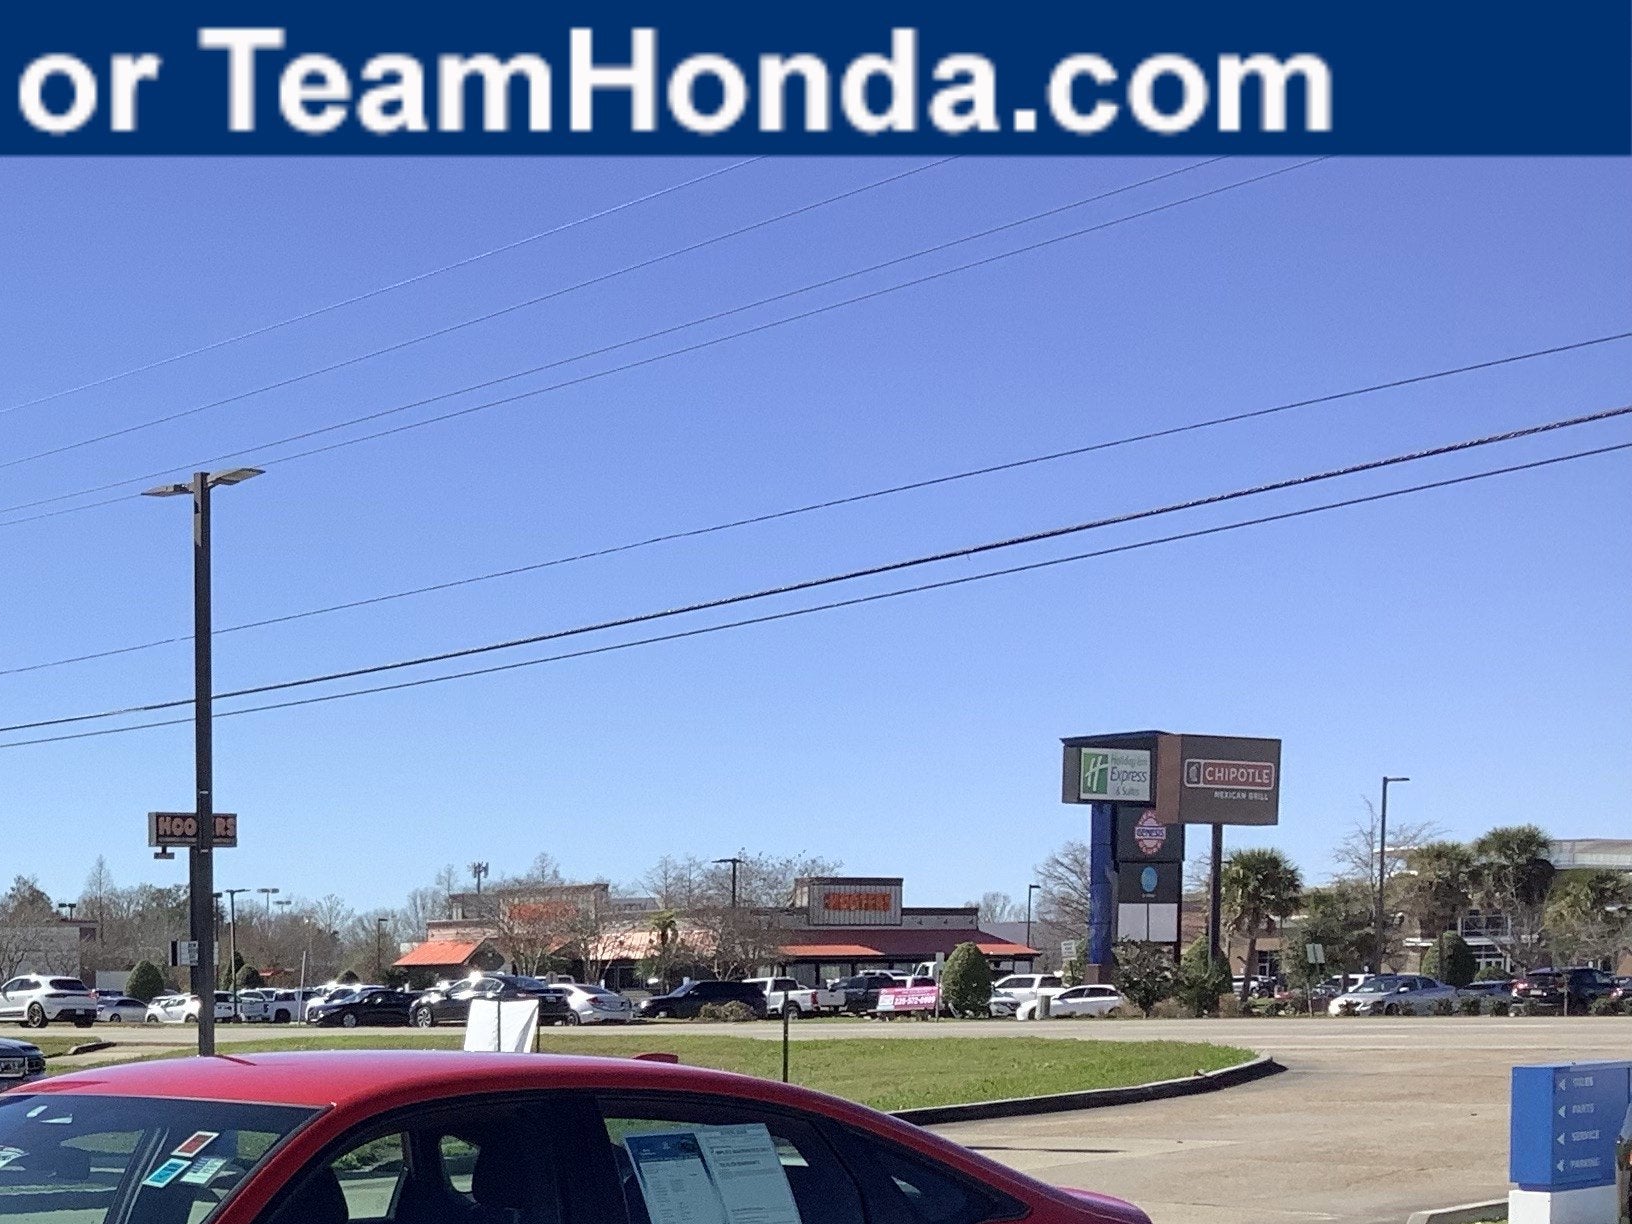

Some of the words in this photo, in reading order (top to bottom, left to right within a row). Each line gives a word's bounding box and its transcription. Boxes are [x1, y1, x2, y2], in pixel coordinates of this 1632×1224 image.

[1110, 767, 1147, 785] Express
[1205, 767, 1270, 784] CHIPOTLE
[1214, 790, 1246, 800] MEXICAN
[1248, 791, 1269, 801] GRILL
[158, 816, 236, 836] HOORS
